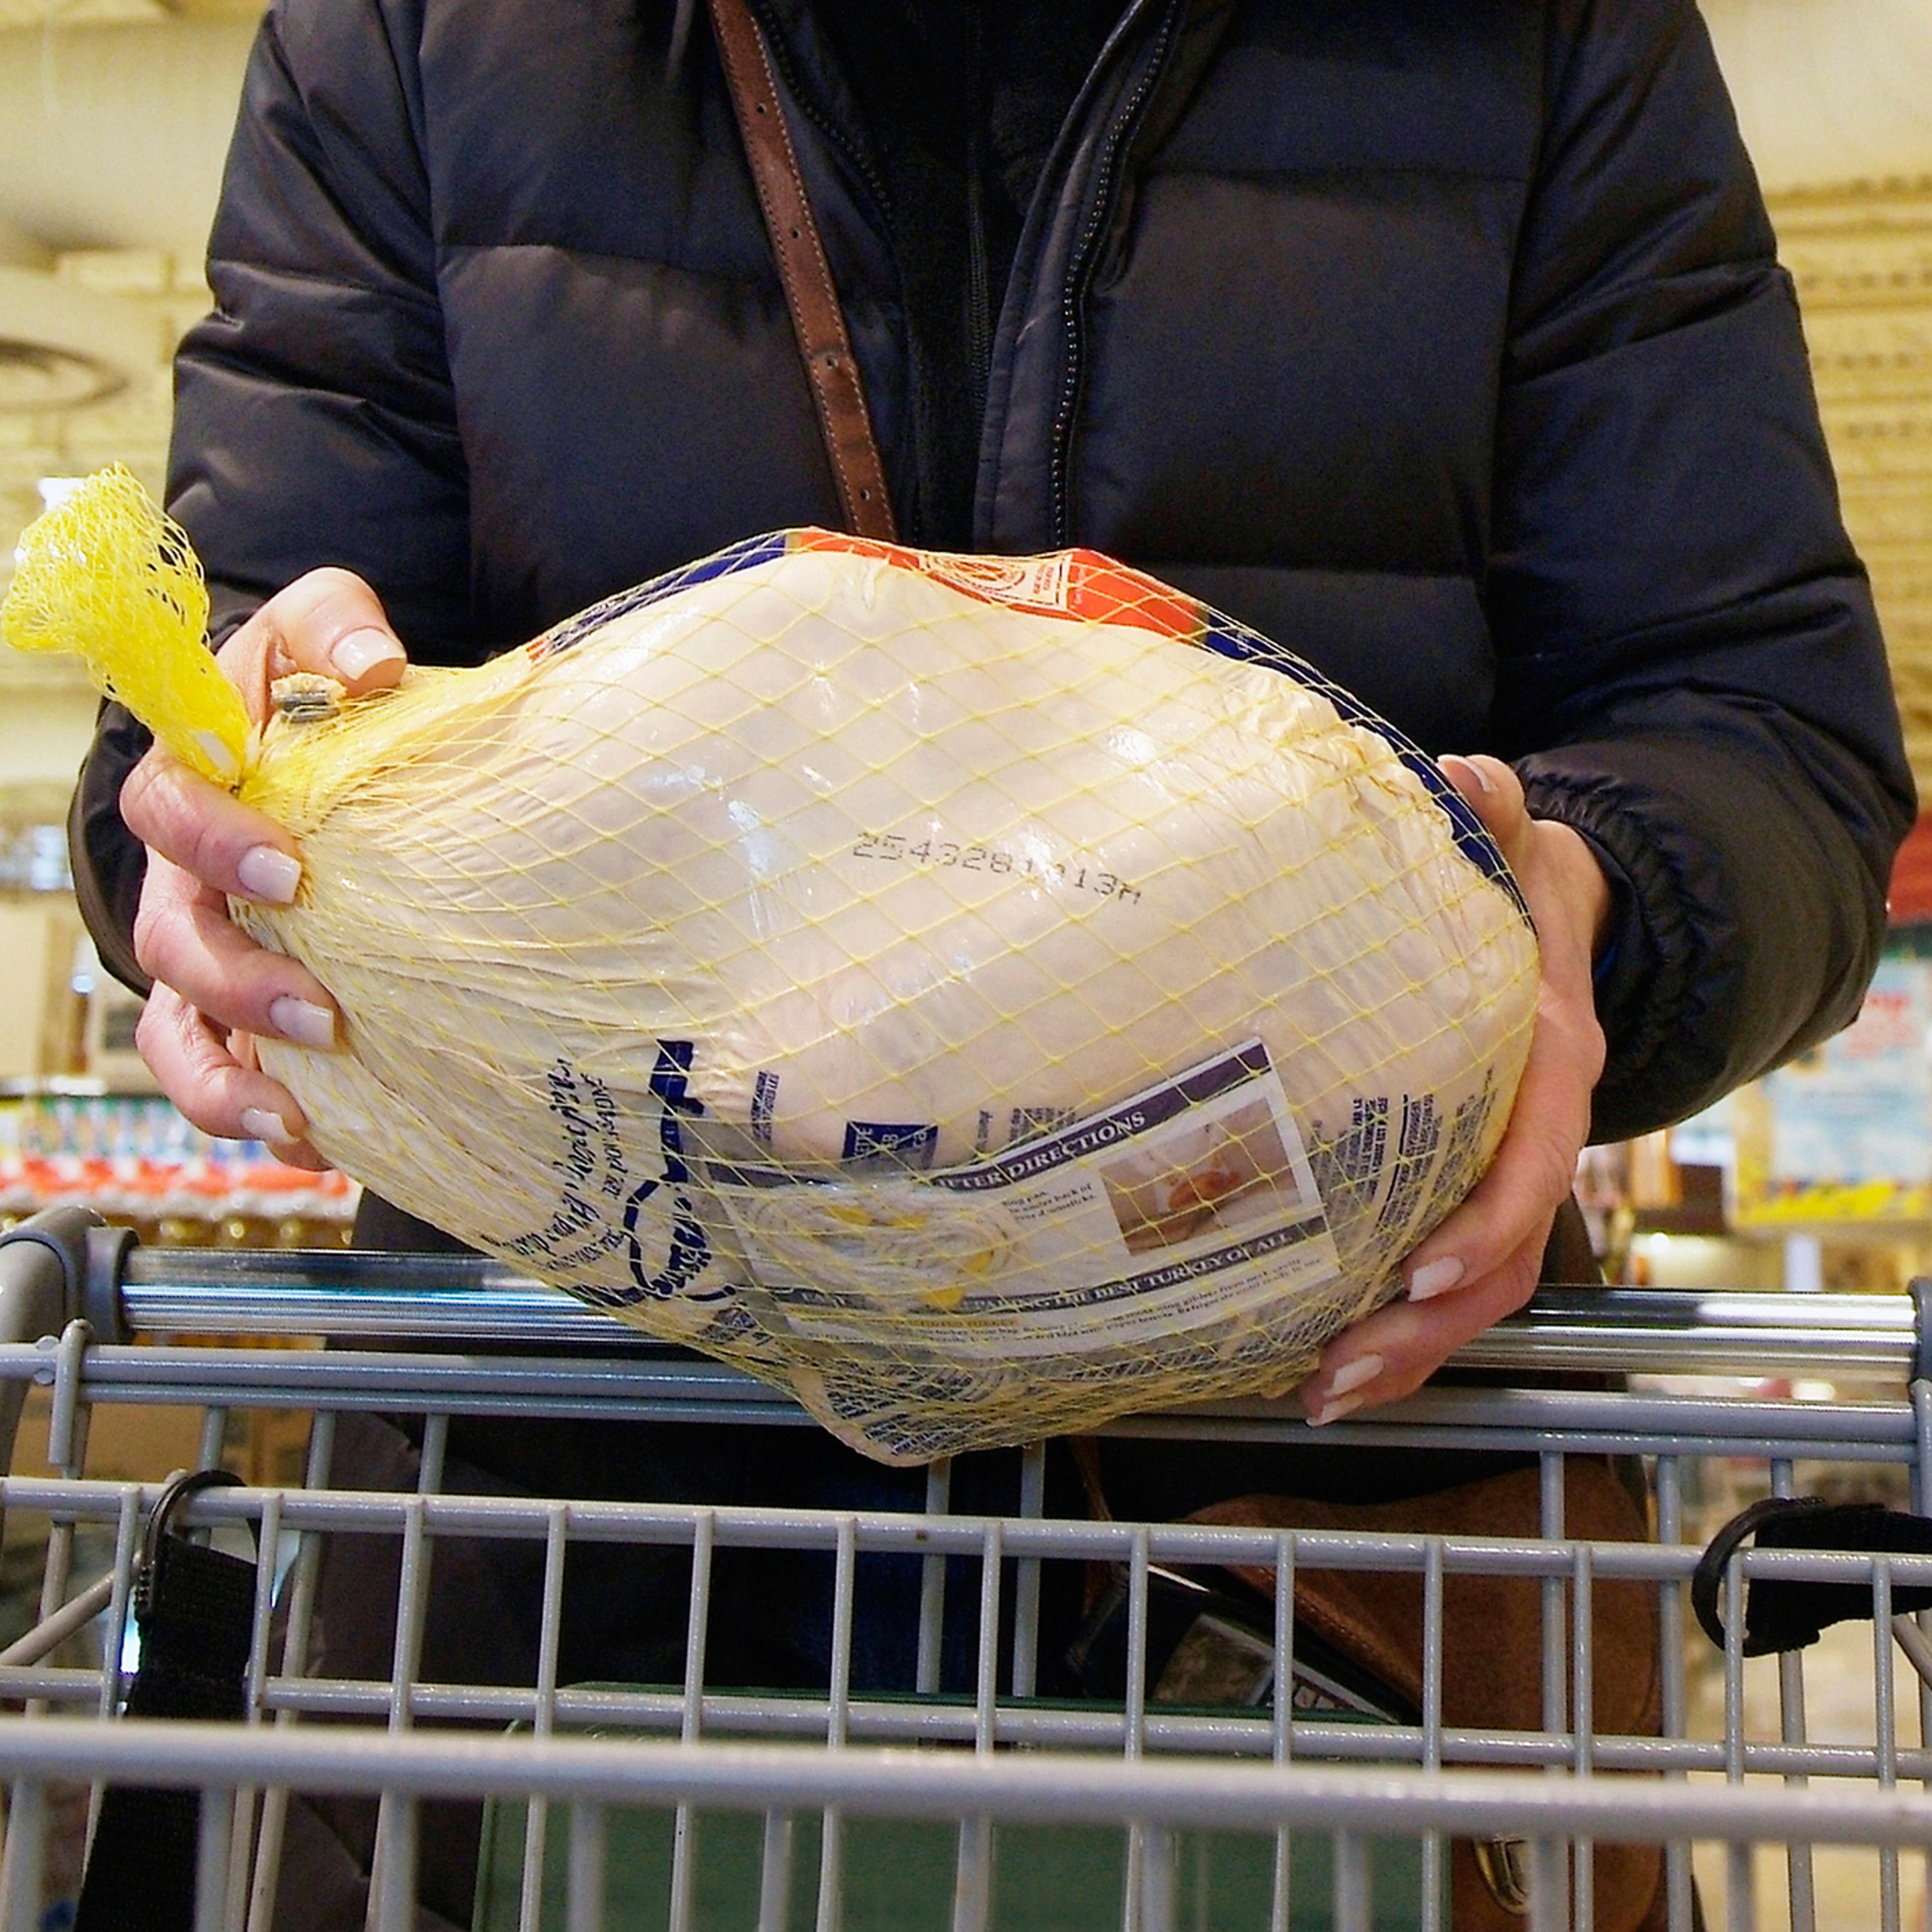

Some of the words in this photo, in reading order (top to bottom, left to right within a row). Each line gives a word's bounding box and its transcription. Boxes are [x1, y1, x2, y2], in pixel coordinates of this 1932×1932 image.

[1007, 1110, 1146, 1177] DIRECTIONS
[1145, 1258, 1224, 1287] TURKEY
[1226, 1248, 1251, 1261] O
[1257, 1232, 1293, 1253] ALL
